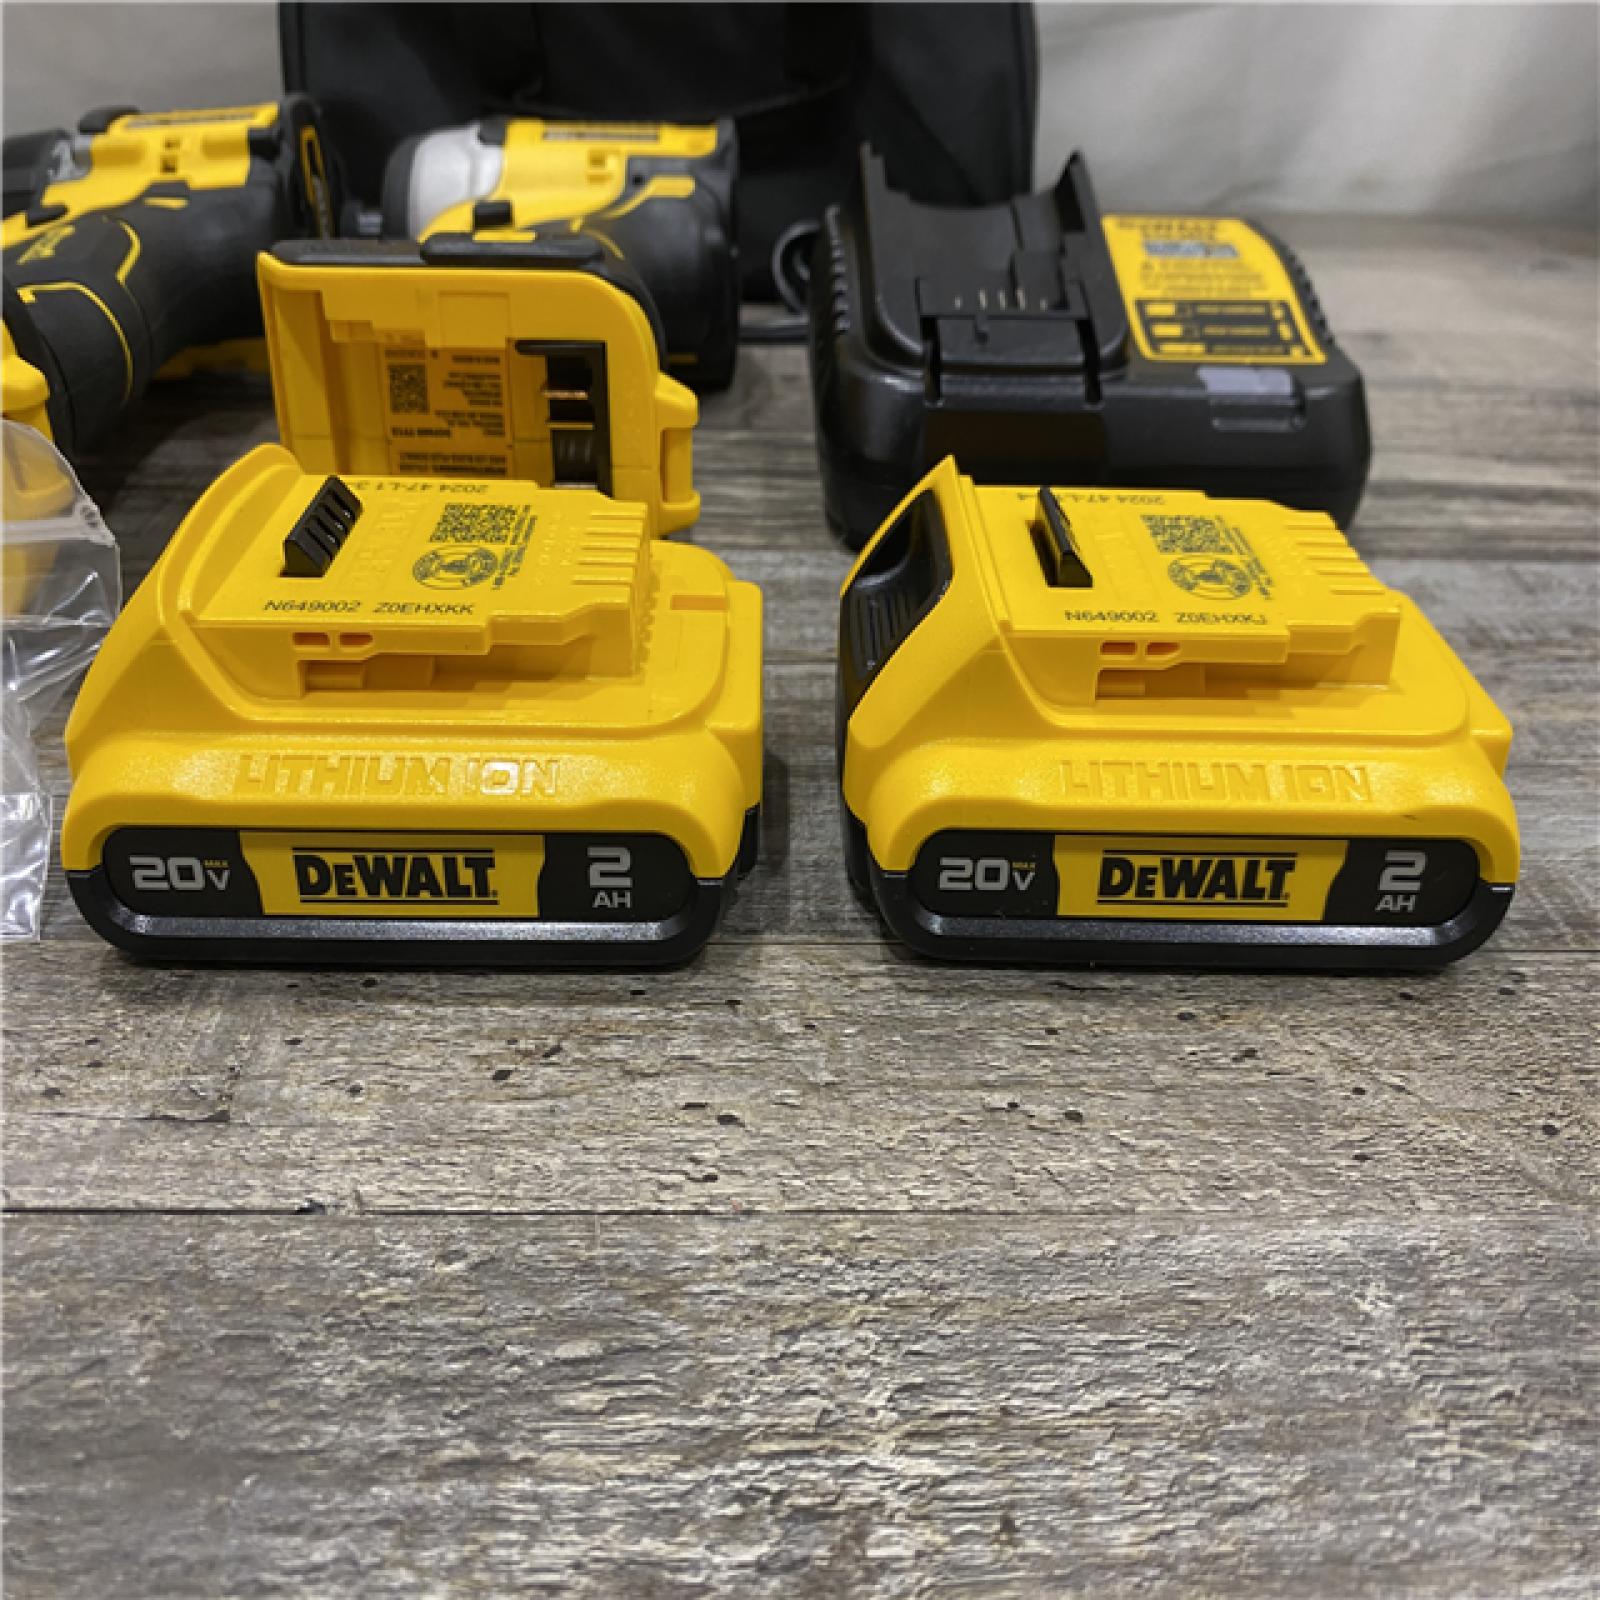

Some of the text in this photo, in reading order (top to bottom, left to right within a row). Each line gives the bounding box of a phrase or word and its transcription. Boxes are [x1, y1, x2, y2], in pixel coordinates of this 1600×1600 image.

[262, 599, 363, 614] N649002
[1064, 609, 1160, 624] N649002
[234, 754, 559, 797] LITHIUM ION
[1061, 760, 1372, 802] LITHIUM ION
[293, 852, 498, 900] DEWALT
[586, 846, 632, 889] 2
[1096, 856, 1295, 901] DEWALT
[1378, 850, 1426, 891] 2
[592, 890, 632, 908] AH
[1375, 894, 1416, 913] AH
